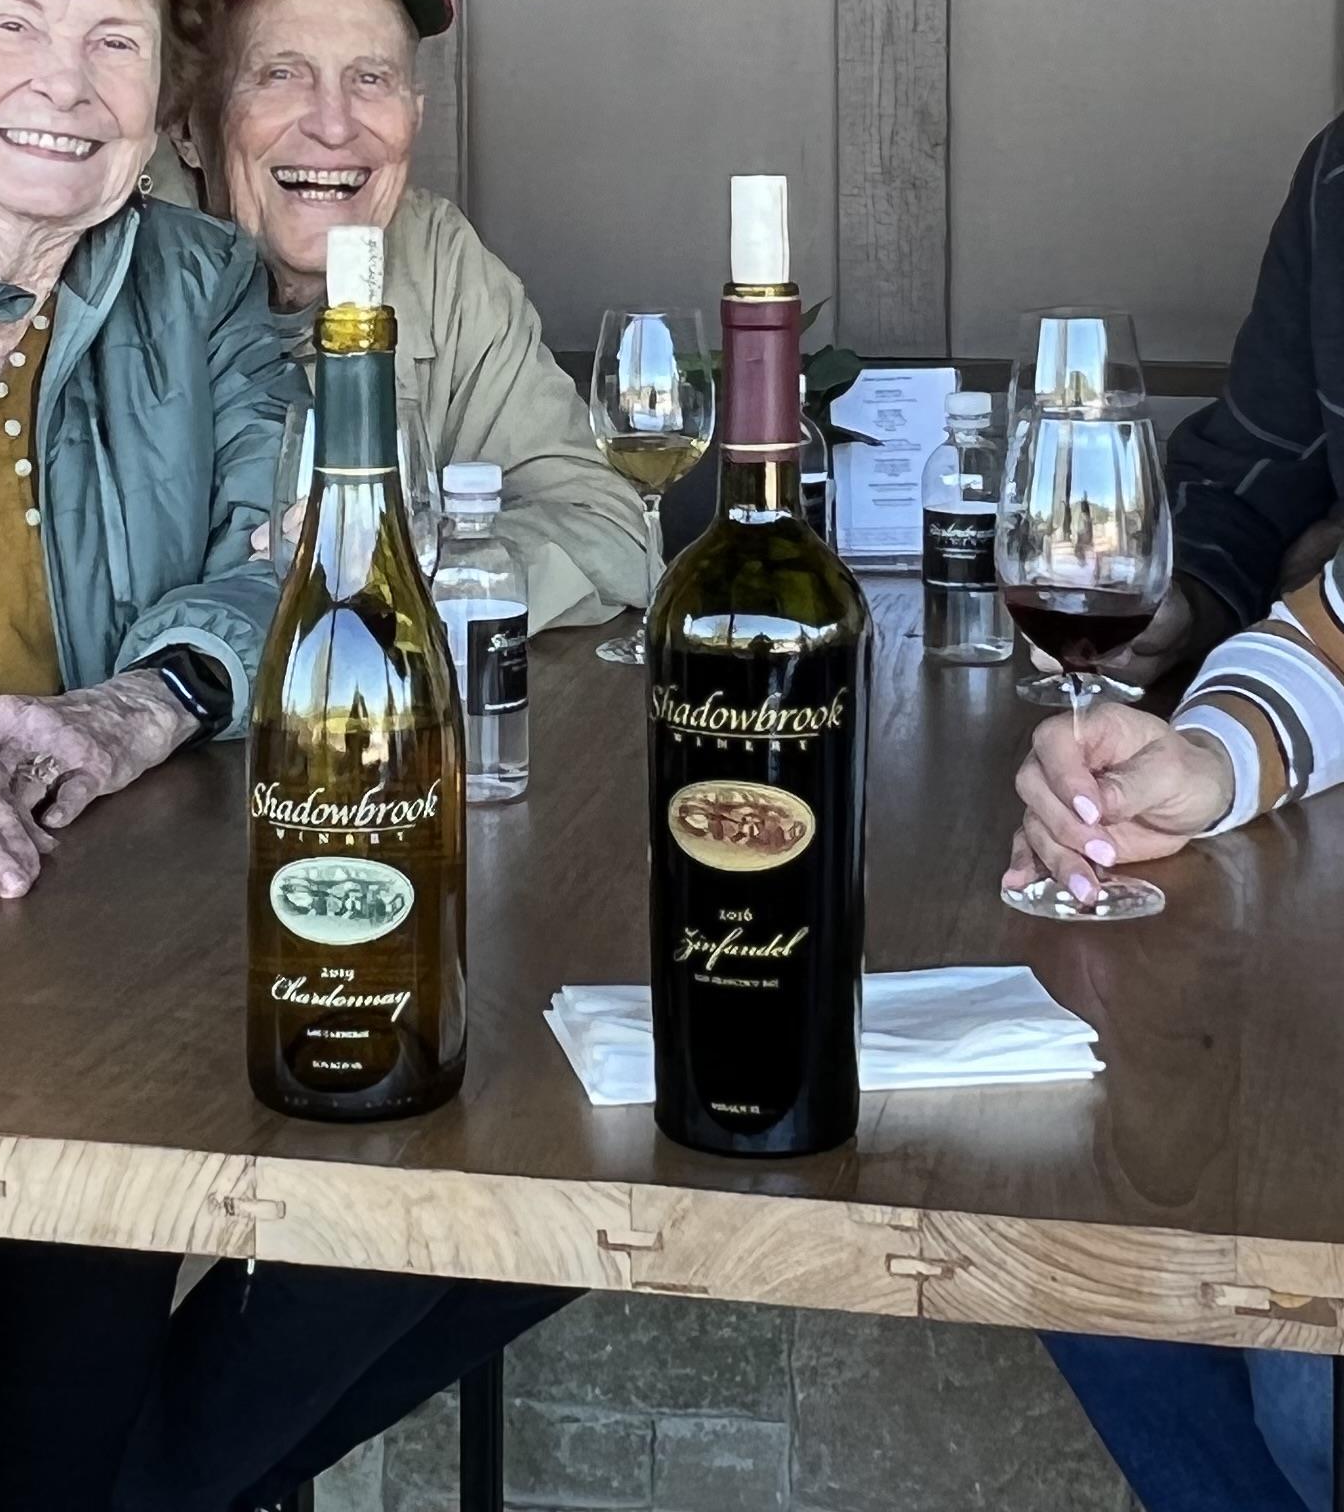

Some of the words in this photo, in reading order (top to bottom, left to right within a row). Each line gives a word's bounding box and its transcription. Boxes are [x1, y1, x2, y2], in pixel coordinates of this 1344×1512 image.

[650, 685, 848, 732] Shadowbrook
[251, 778, 441, 826] Shadowbrook
[719, 908, 753, 922] 2016
[674, 926, 809, 971] Zinfandel
[271, 974, 411, 1023] Chardonnay
